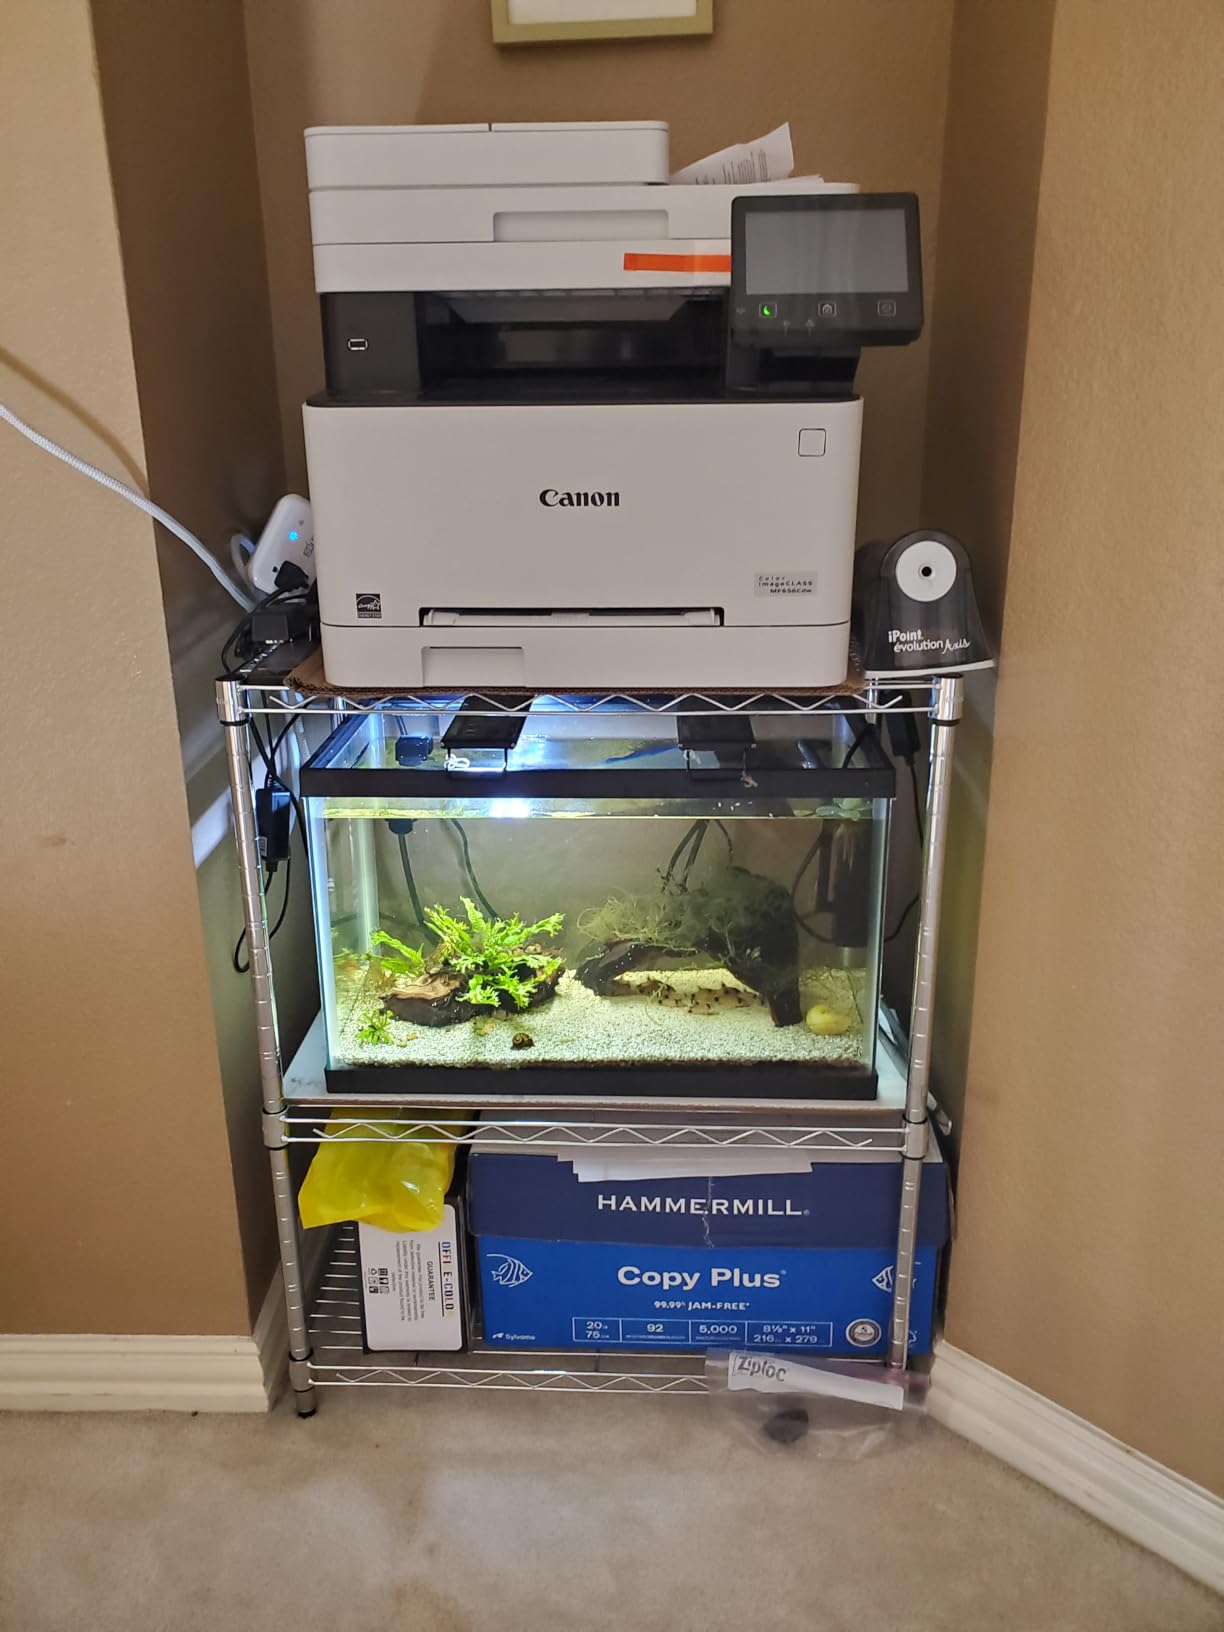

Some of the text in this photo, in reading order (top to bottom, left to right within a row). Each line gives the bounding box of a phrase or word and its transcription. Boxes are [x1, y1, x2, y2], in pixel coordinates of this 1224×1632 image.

[538, 488, 620, 507] Canon
[887, 629, 922, 643] iPoint
[426, 1260, 436, 1301] GUARANTEE
[617, 1266, 781, 1291] Copy Plus
[646, 1323, 664, 1333] 92
[699, 1324, 738, 1335] 5,000
[753, 1334, 775, 1343] 216
[795, 1335, 818, 1344] 279
[737, 1355, 787, 1383] Ziploc
